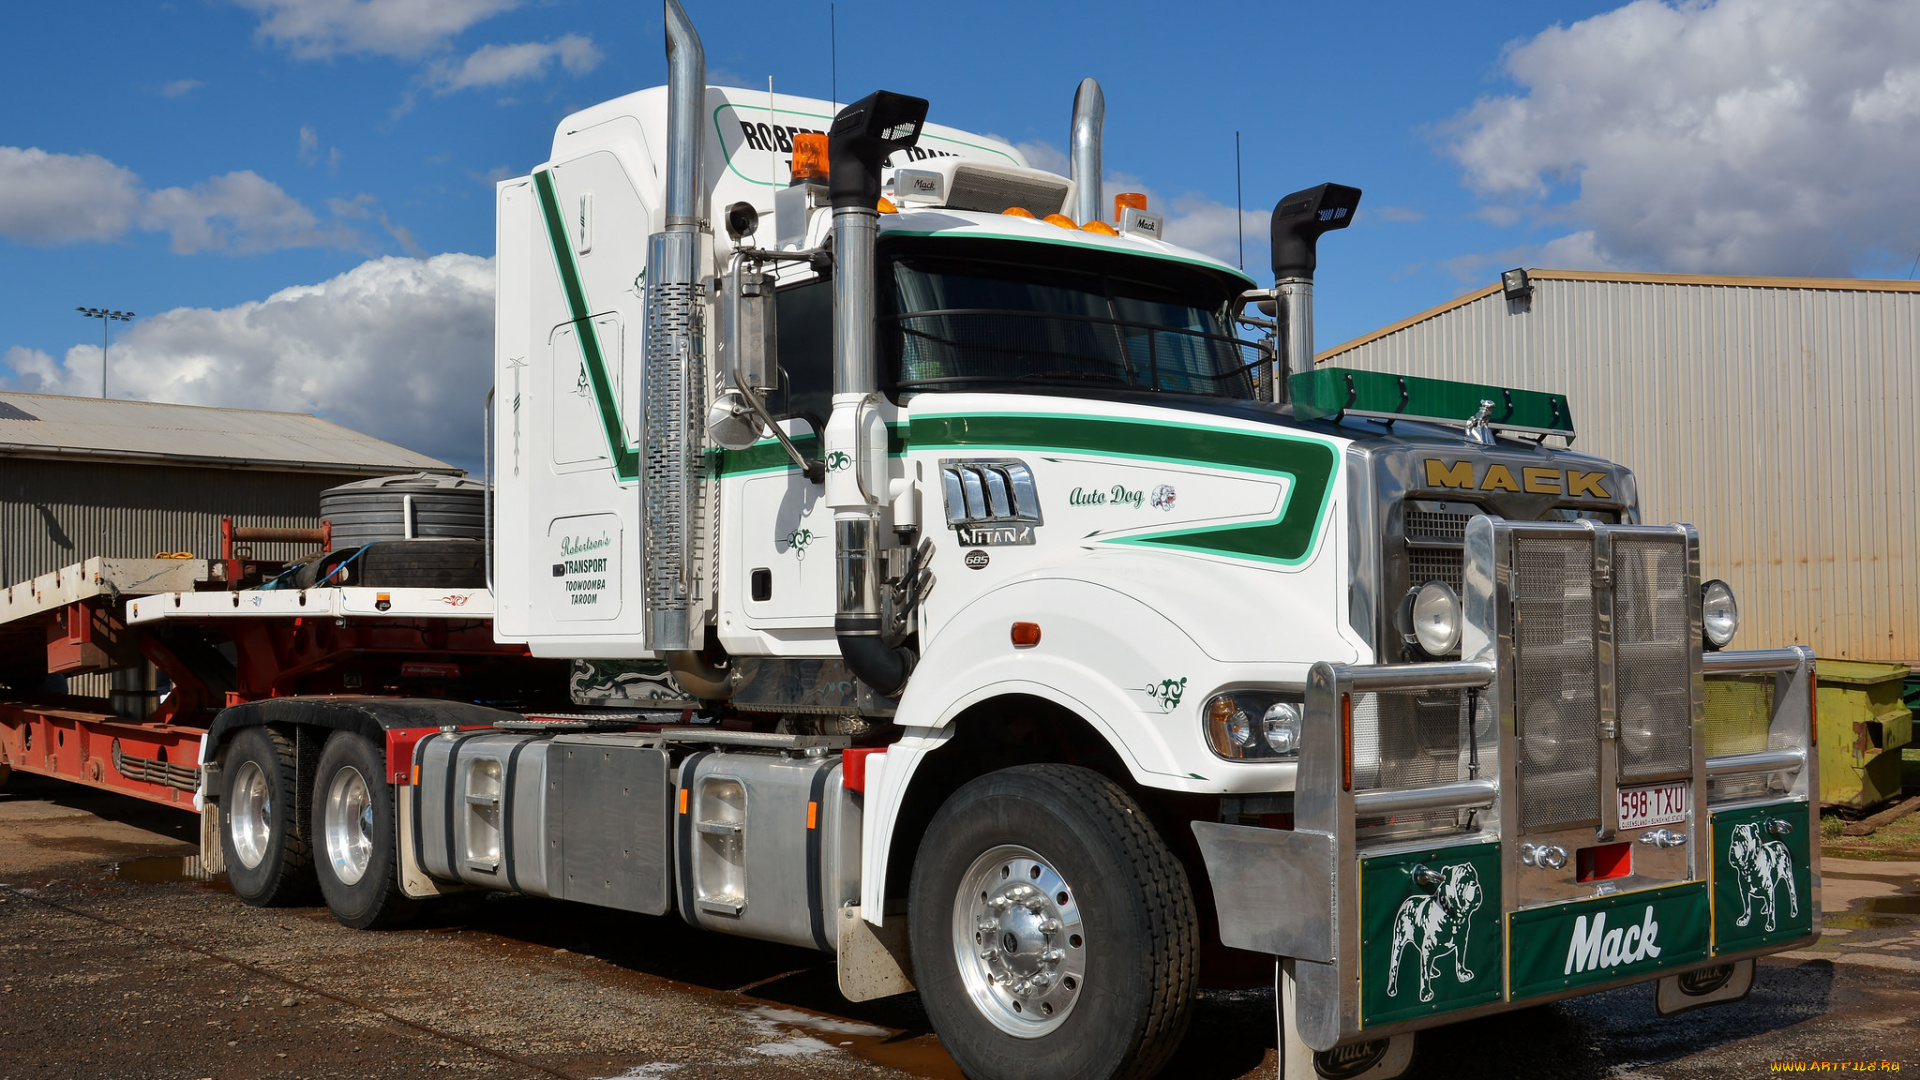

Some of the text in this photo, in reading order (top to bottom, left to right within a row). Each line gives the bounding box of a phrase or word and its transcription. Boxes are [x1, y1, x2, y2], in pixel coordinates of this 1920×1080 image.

[914, 179, 936, 191] Mack
[1136, 218, 1155, 231] Mack
[1425, 459, 1611, 498] MACK
[1069, 484, 1145, 509] Auto Dog
[561, 530, 612, 557] Robertson's
[564, 558, 608, 575] TRANSPORT
[965, 555, 989, 565] 685
[565, 579, 606, 591] TOOWOOMBA
[571, 593, 598, 605] TAROOM
[1621, 818, 1648, 828] QUEENSLAND
[1651, 816, 1670, 825] SUNSHINE
[1564, 905, 1662, 975] Mack
